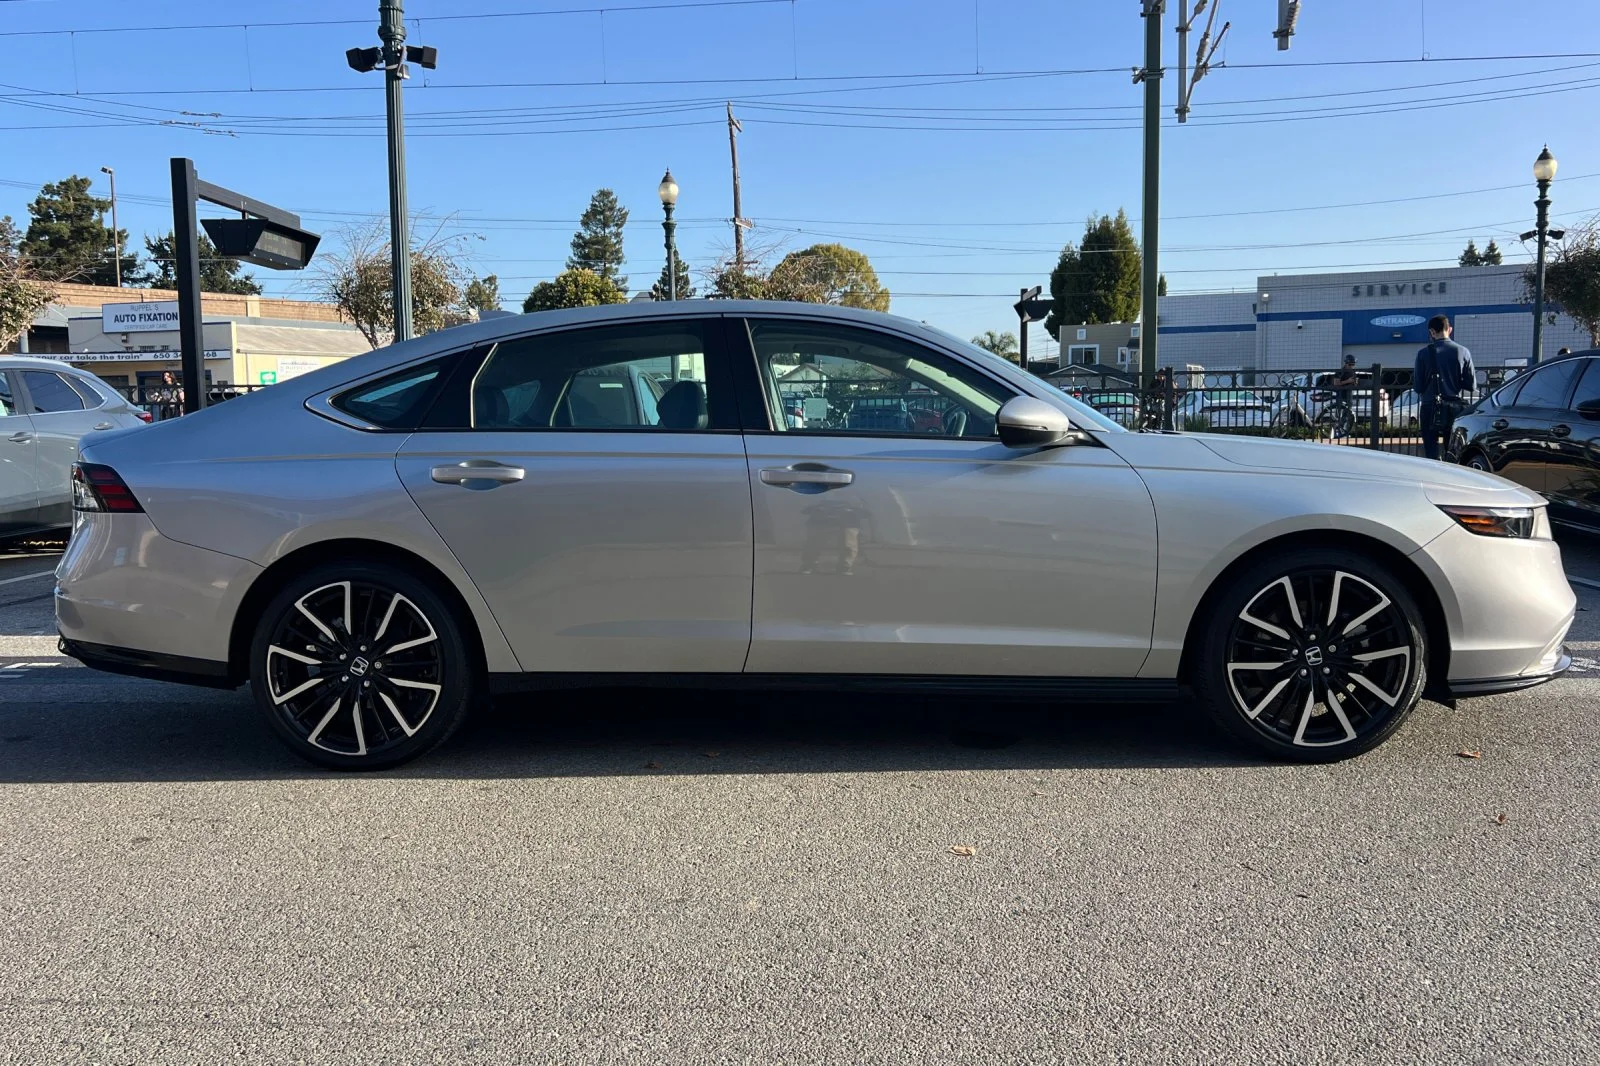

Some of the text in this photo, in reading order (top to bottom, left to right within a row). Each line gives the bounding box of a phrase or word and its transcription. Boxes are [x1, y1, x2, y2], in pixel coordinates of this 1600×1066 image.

[1352, 282, 1446, 296] SERVICE
[114, 312, 178, 323] AUTO FIXATION
[1376, 317, 1420, 325] ENTRANCE
